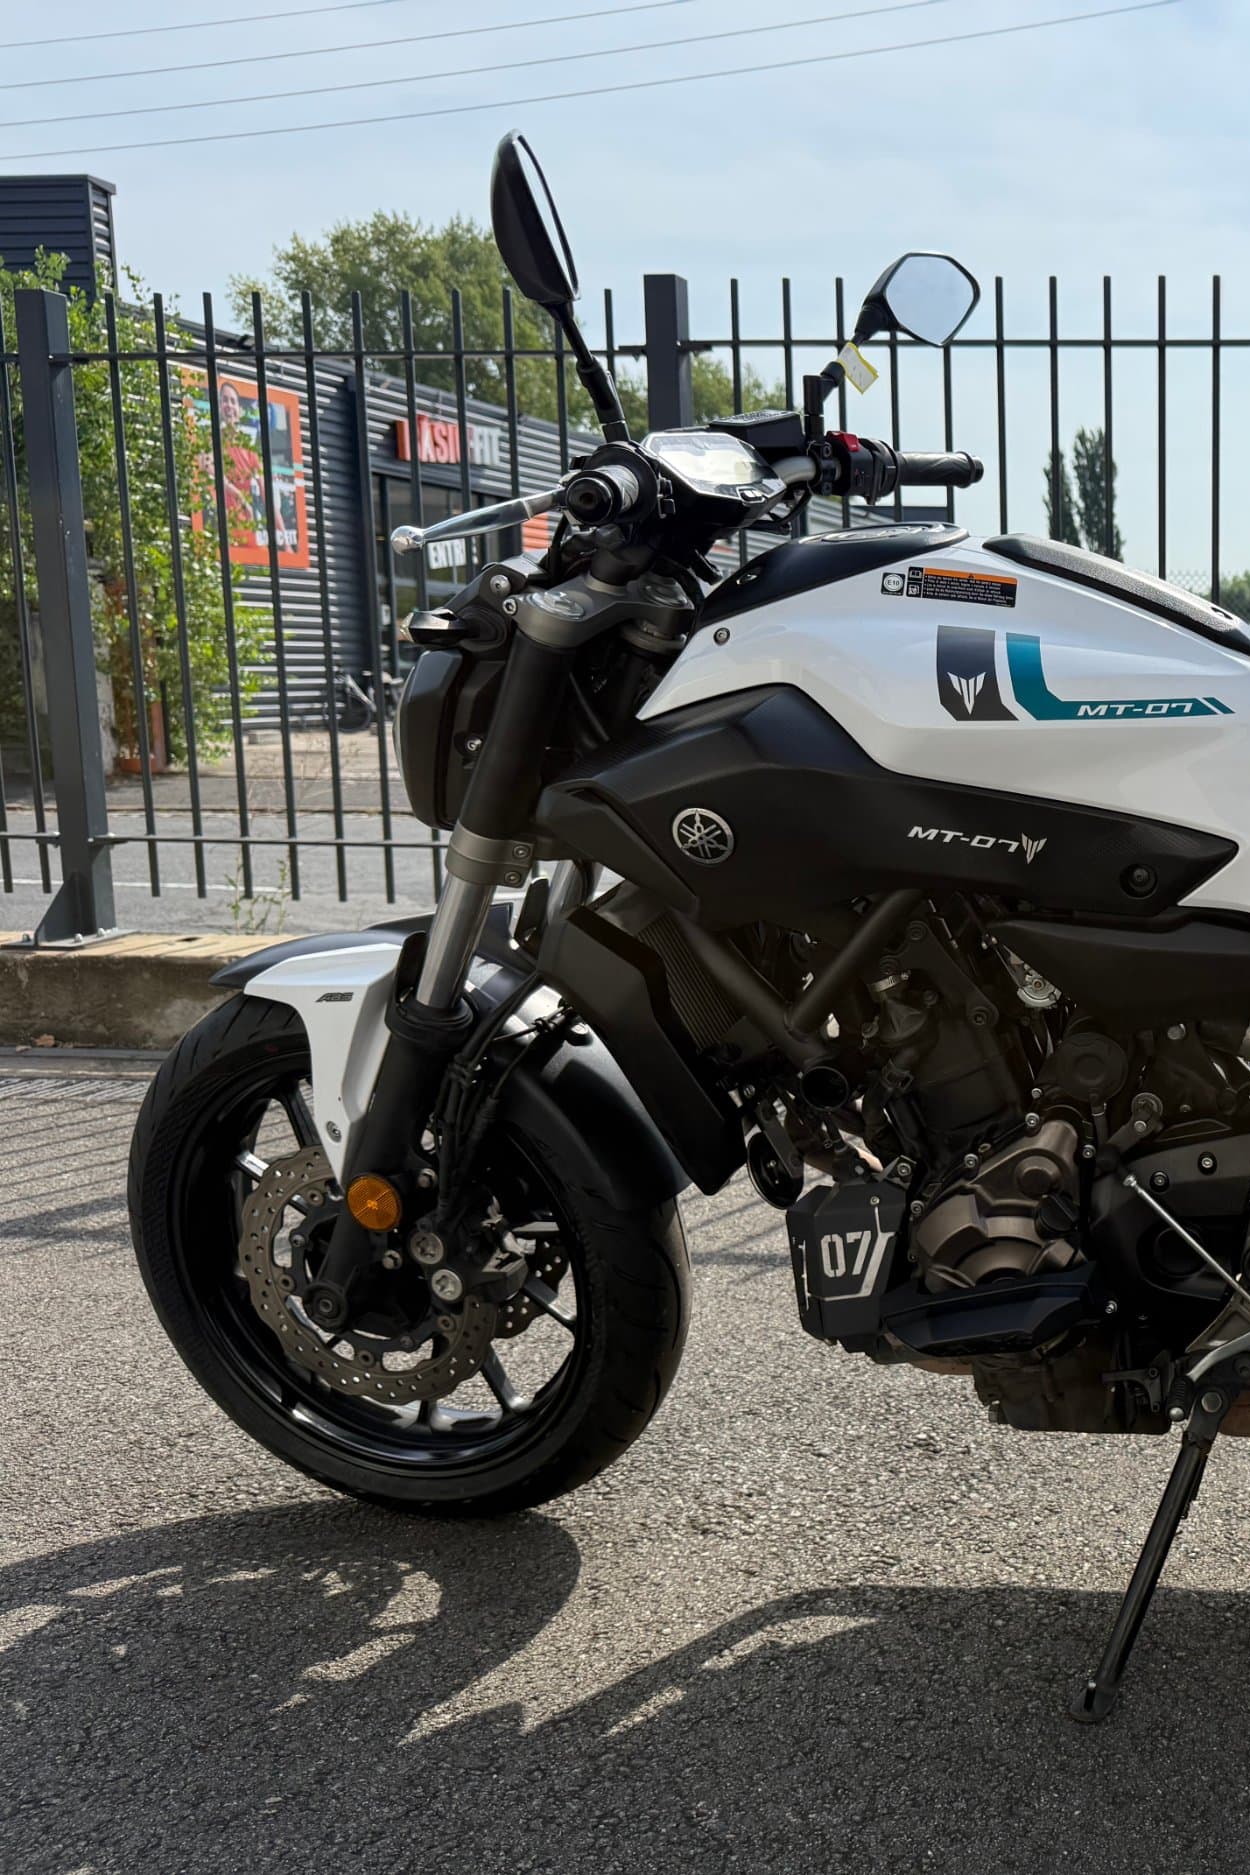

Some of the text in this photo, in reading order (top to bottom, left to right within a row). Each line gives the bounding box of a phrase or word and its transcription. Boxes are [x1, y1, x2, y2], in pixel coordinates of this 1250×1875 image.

[1077, 702, 1193, 717] MT-07
[907, 825, 1020, 853] MT-07
[820, 1230, 872, 1278] 07
